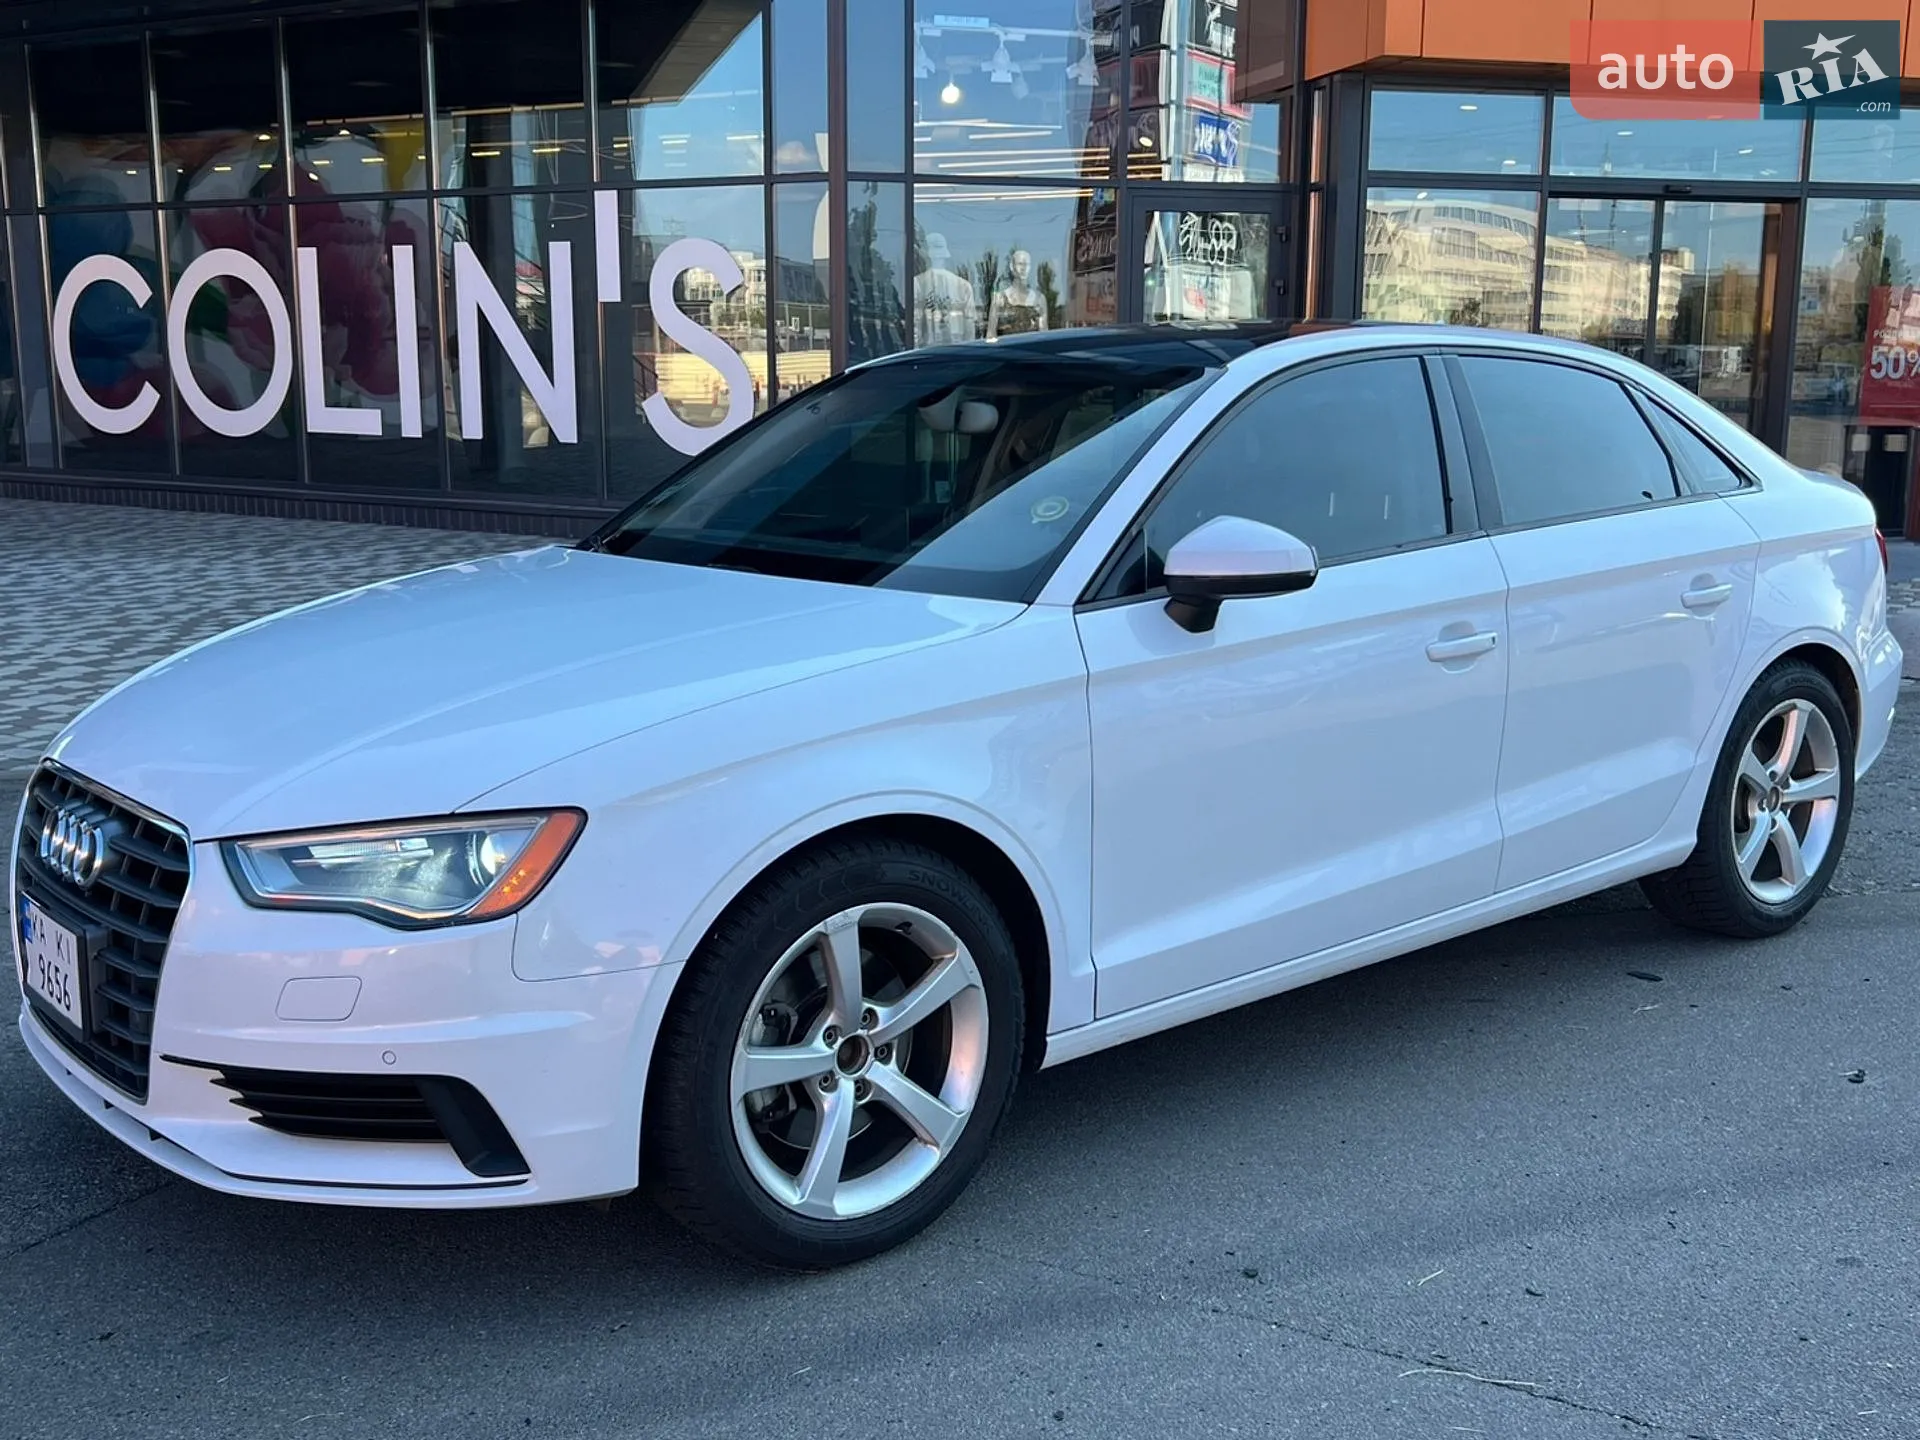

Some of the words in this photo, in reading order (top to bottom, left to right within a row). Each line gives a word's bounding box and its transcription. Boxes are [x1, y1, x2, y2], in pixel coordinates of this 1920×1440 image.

[53, 190, 755, 456] COLIN'S
[1870, 345, 1920, 379] 50%
[39, 953, 71, 1012] 9656
